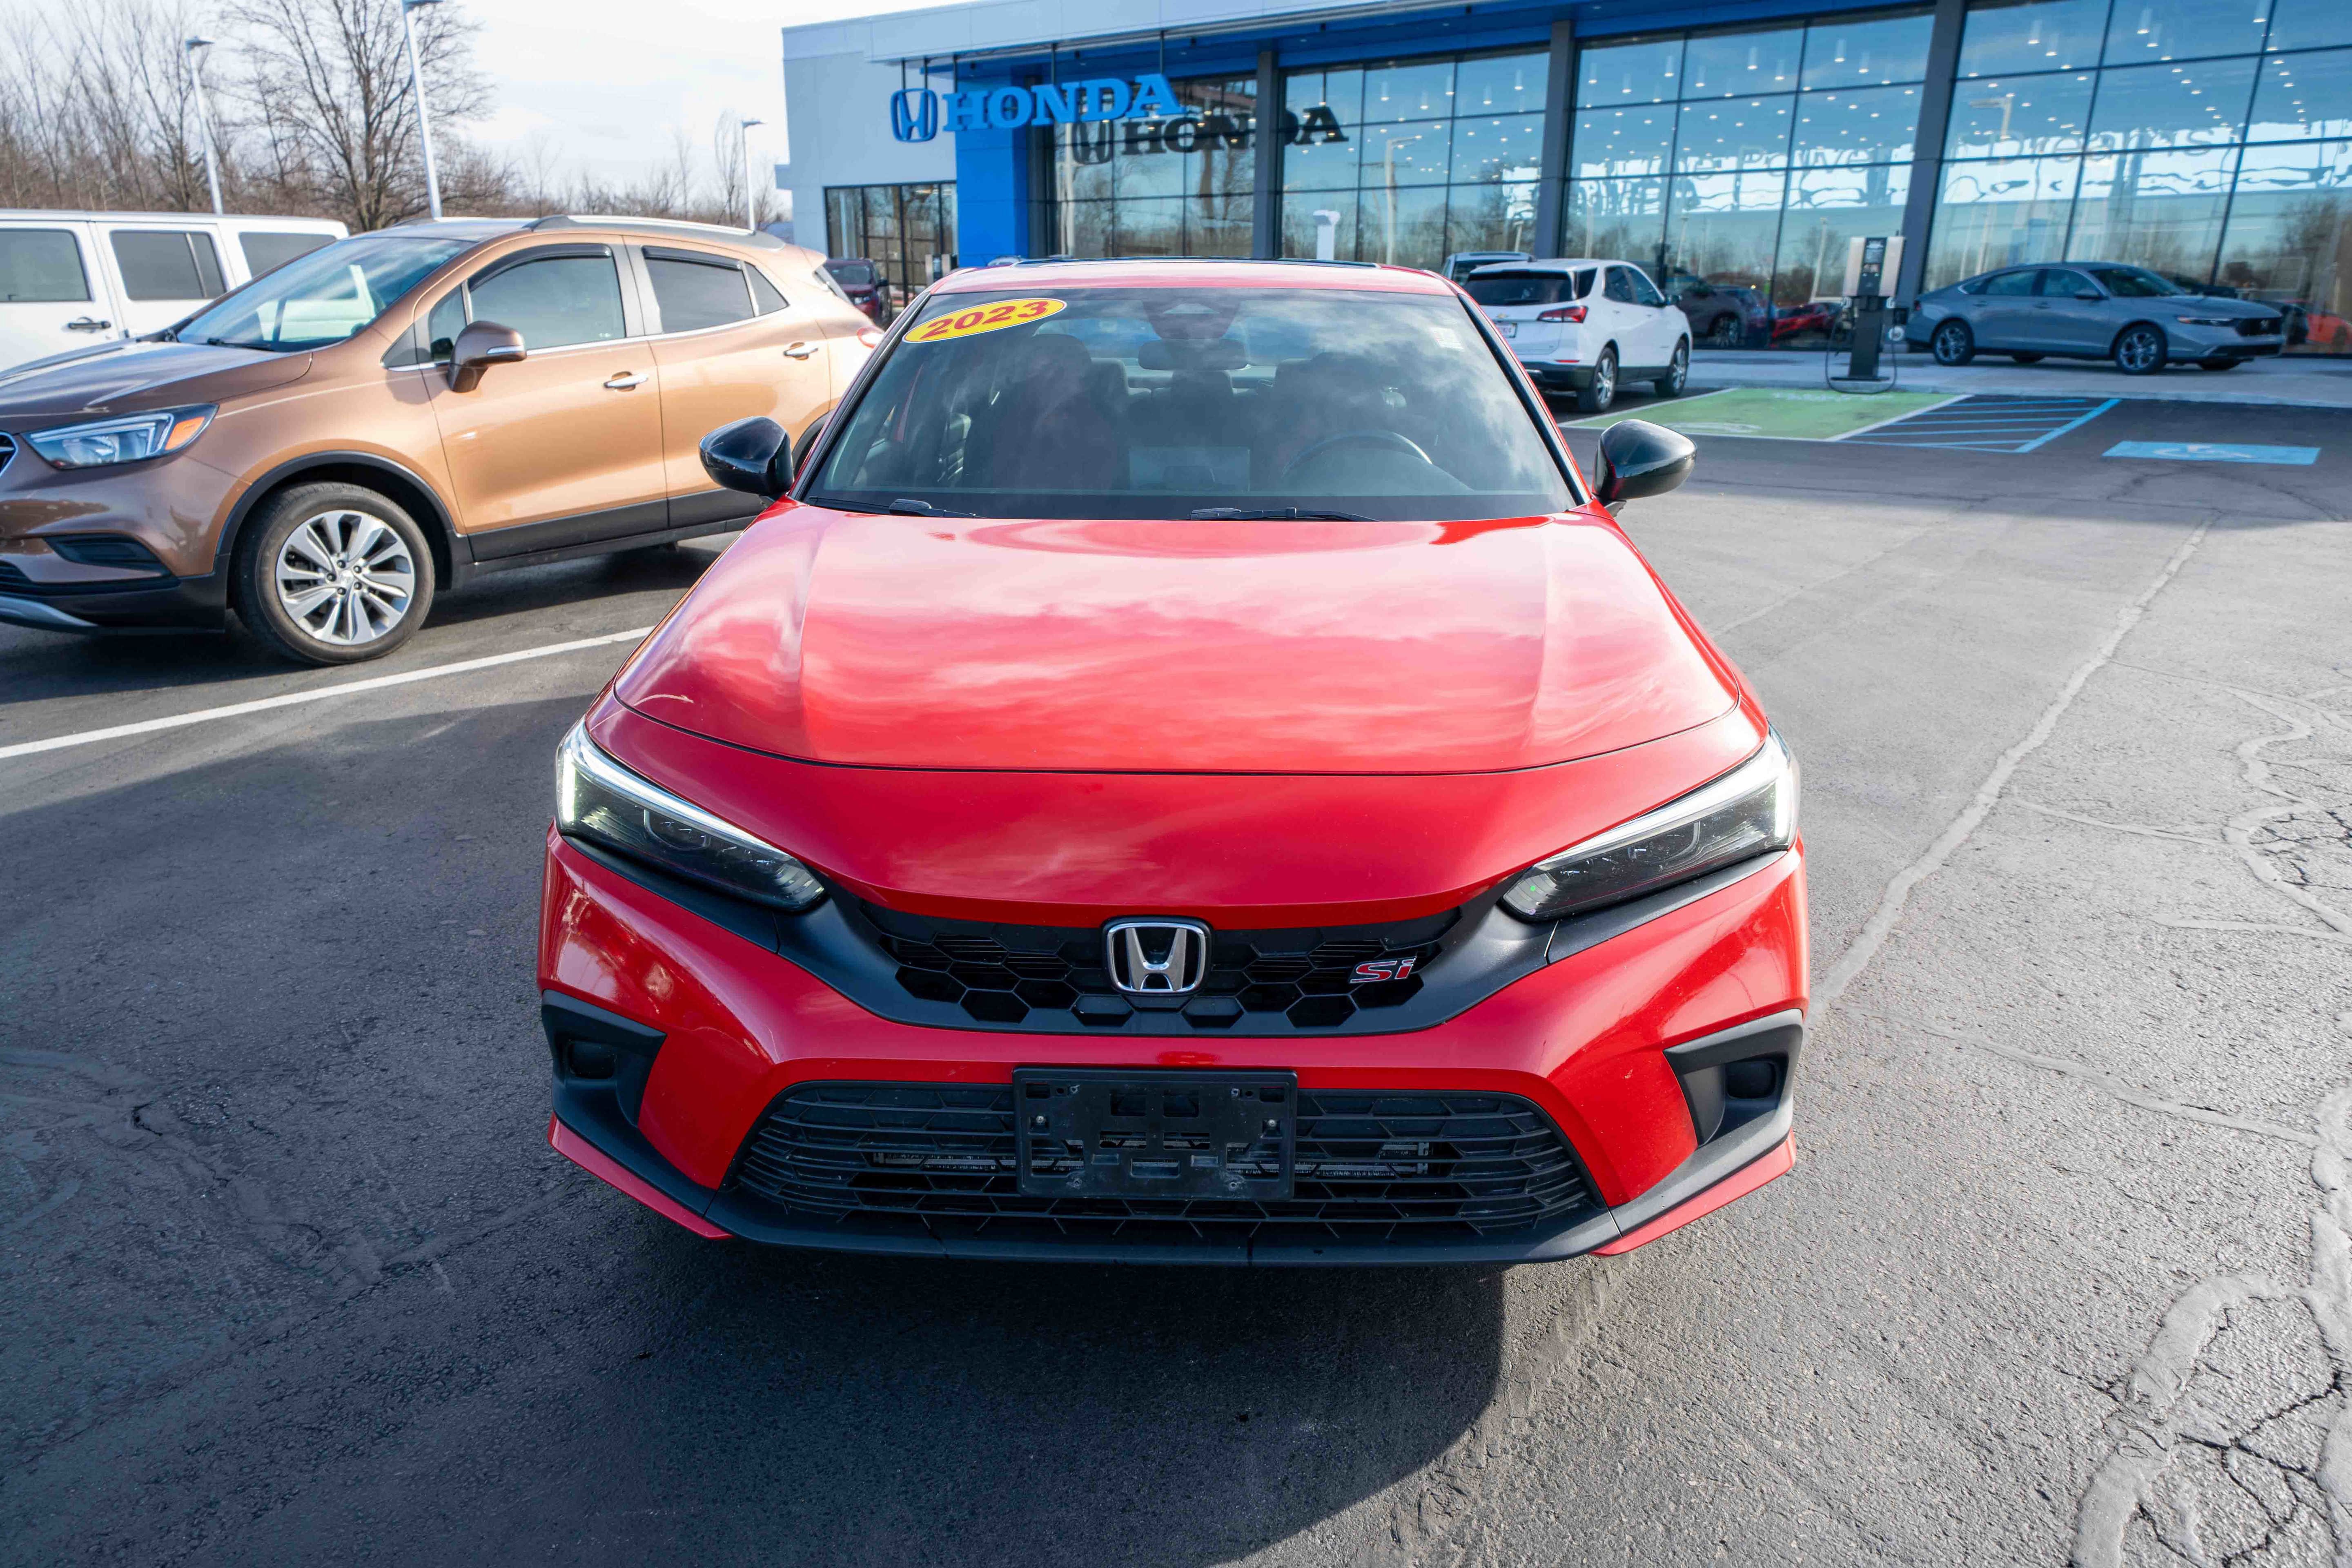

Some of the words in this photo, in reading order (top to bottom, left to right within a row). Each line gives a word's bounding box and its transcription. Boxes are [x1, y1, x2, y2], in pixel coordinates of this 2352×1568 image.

[942, 74, 1187, 131] HONDA
[920, 301, 1050, 340] 2023
[1350, 958, 1417, 984] Si
